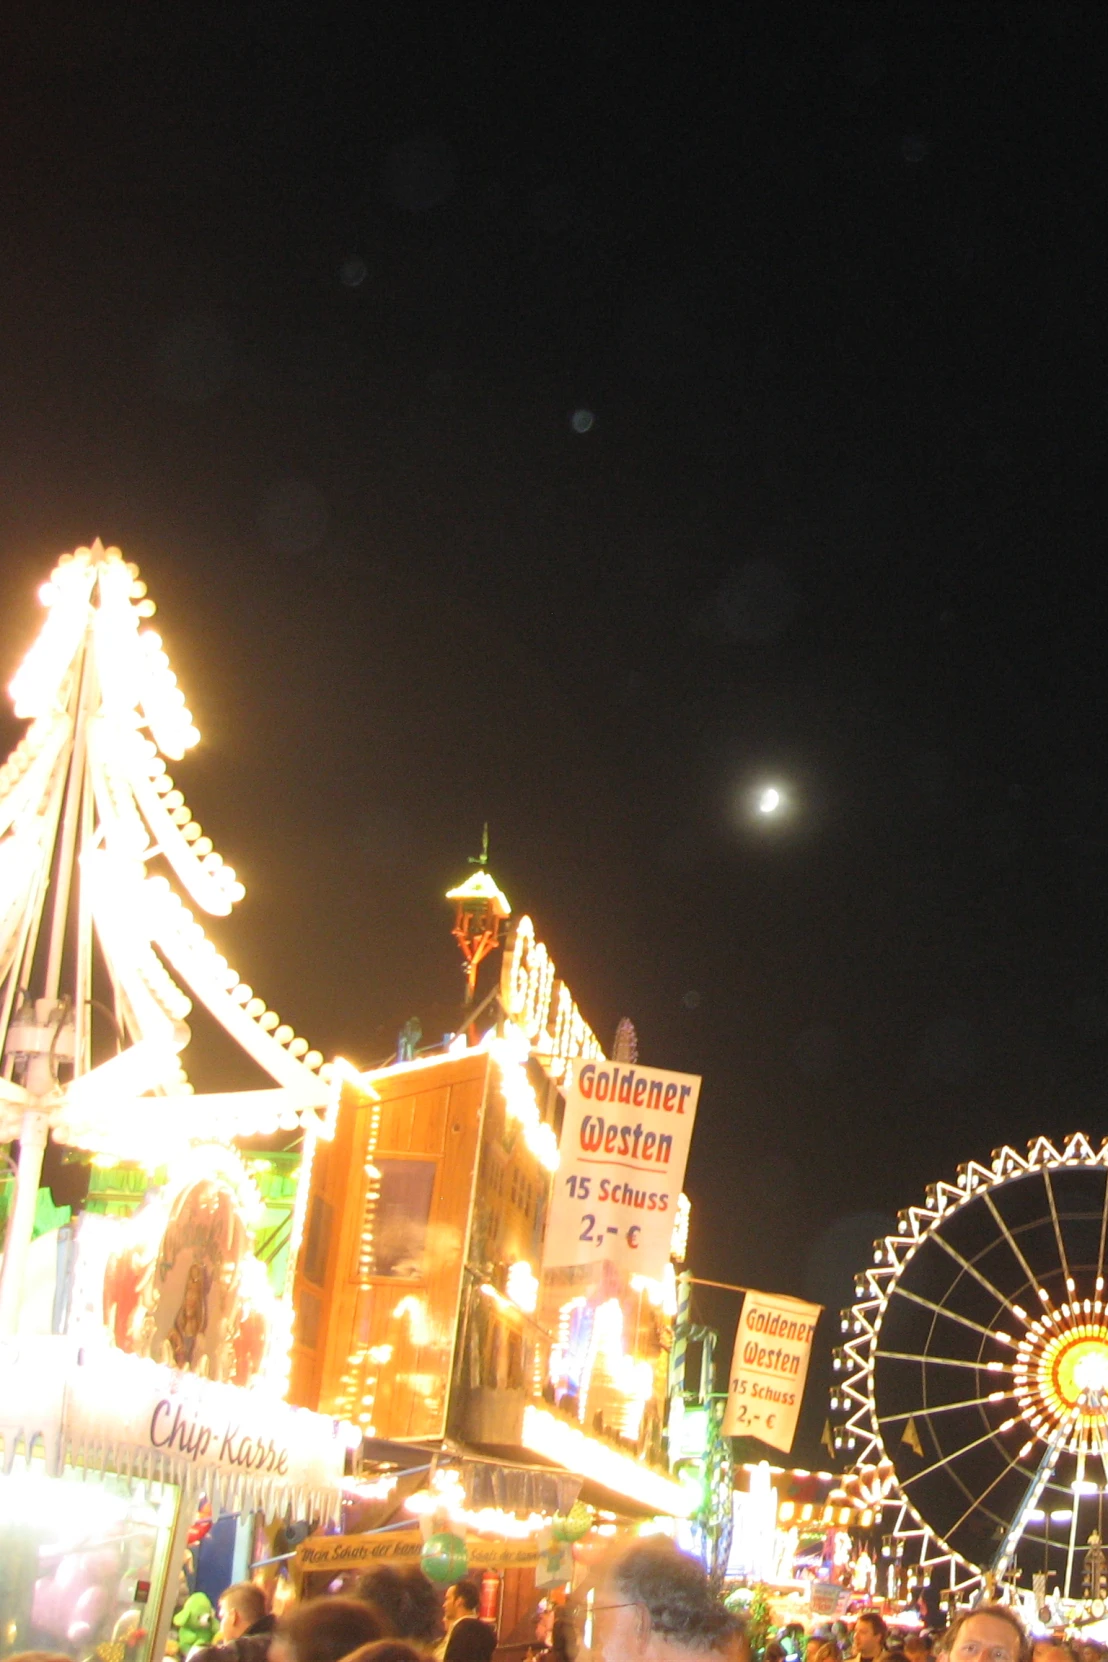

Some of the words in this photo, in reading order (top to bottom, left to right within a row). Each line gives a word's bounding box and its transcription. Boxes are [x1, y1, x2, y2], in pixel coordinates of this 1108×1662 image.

[579, 1064, 692, 1114] Goldener
[580, 1115, 673, 1164] Westen
[565, 1175, 592, 1200] 15
[598, 1179, 669, 1212] Schuss
[579, 1213, 618, 1247] 2,-
[626, 1225, 641, 1249] €
[745, 1308, 816, 1344] Goldener
[743, 1341, 800, 1375] Westen
[732, 1378, 747, 1395] 15
[751, 1382, 796, 1406] Schuss
[766, 1413, 777, 1429] €
